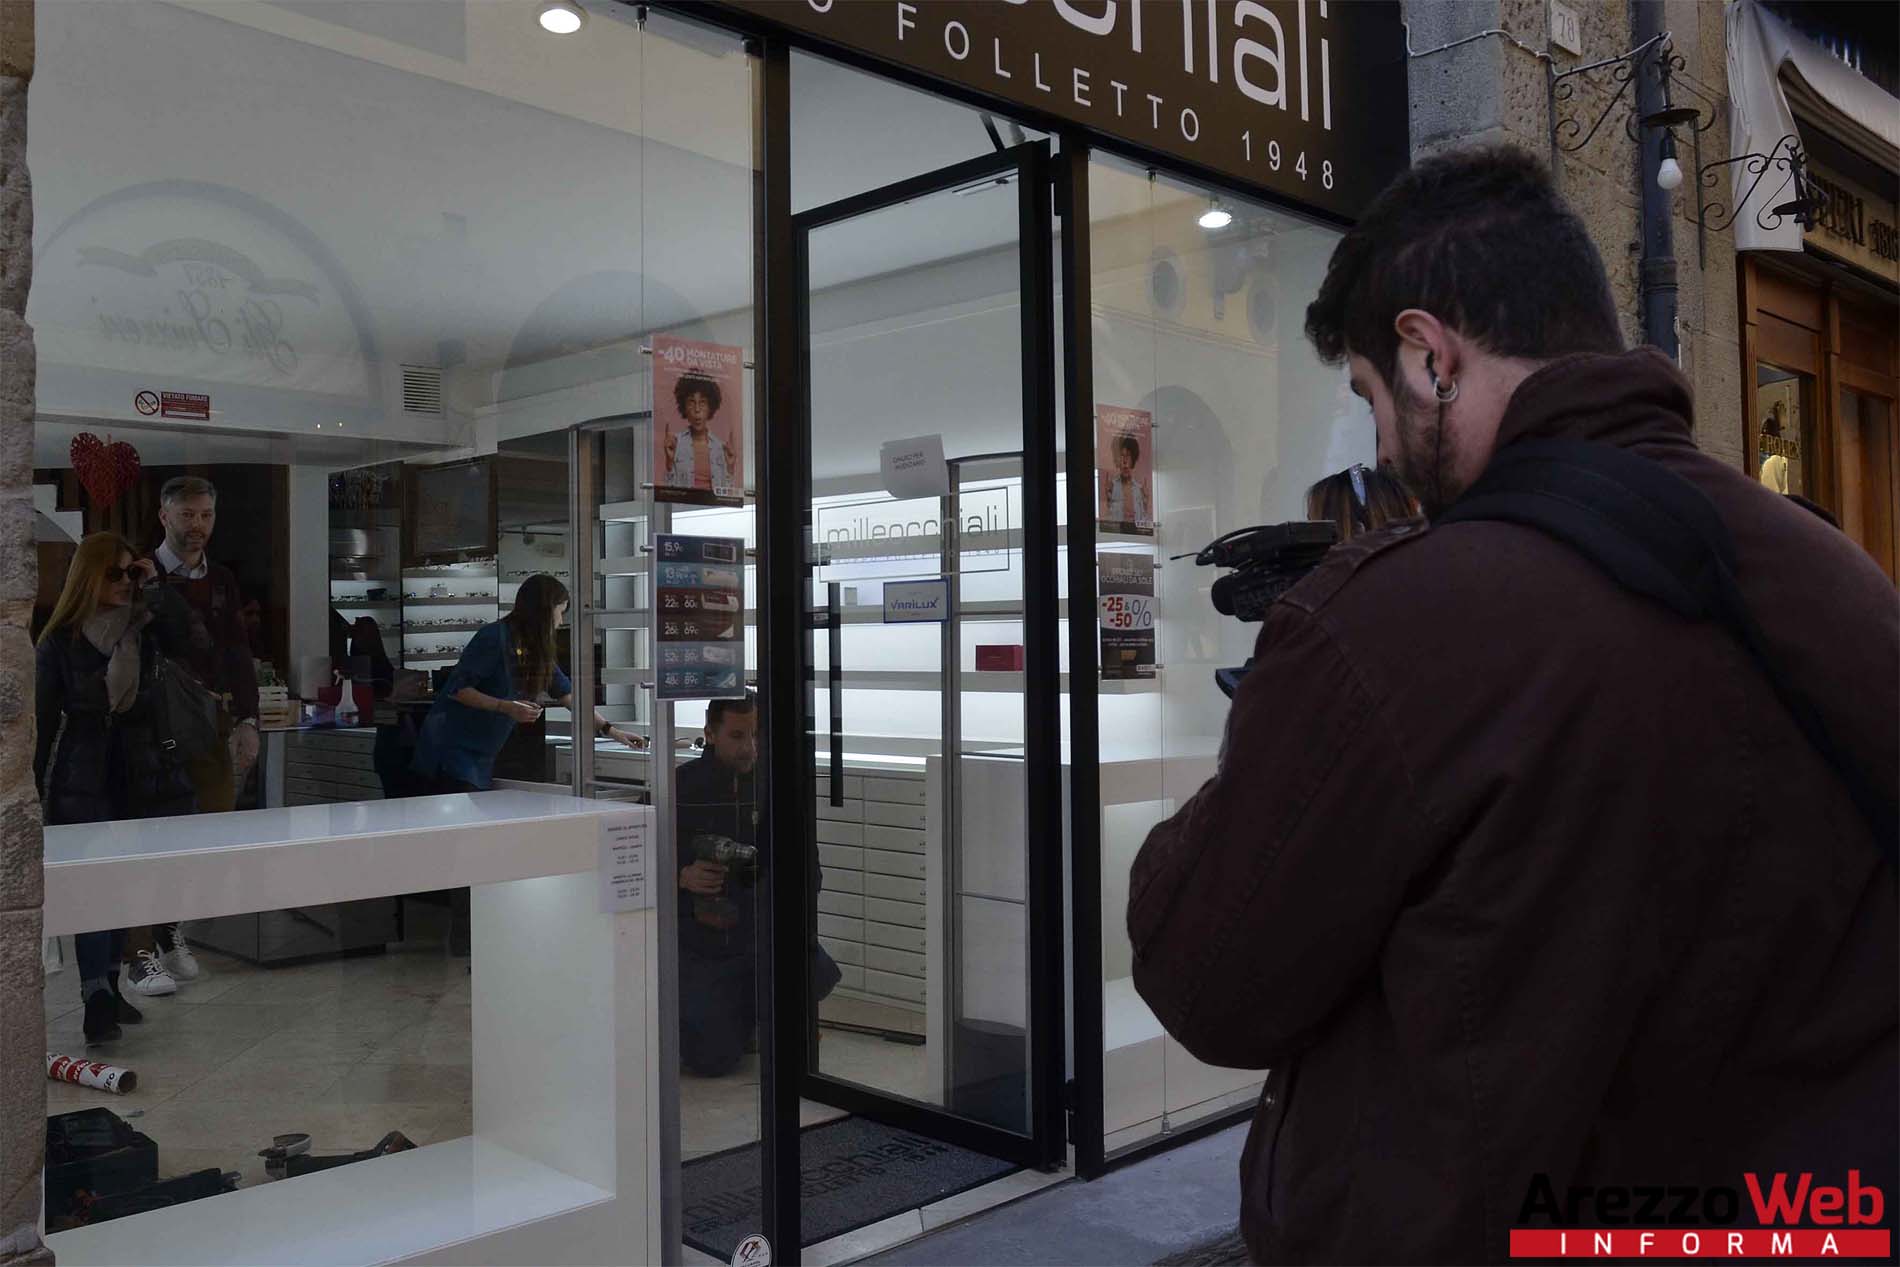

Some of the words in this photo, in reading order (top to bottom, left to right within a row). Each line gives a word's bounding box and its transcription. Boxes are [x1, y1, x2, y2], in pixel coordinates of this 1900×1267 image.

[899, 3, 1200, 141] FOLLETTO
[1242, 130, 1334, 190] 1948
[1102, 597, 1123, 612] -25
[1110, 612, 1133, 628] -50
